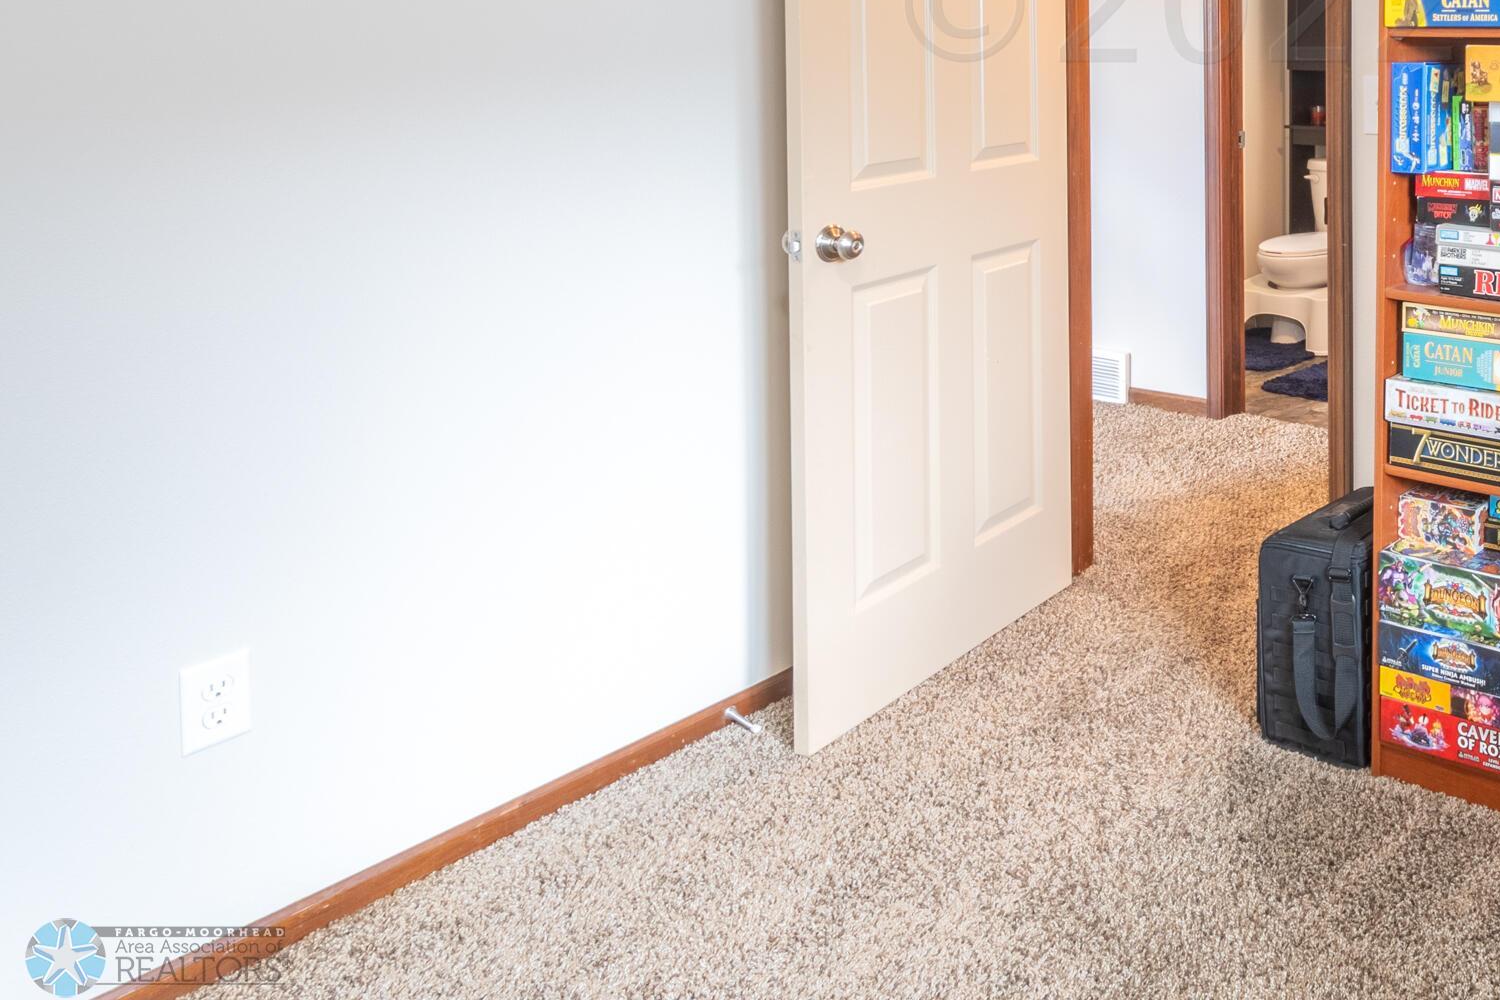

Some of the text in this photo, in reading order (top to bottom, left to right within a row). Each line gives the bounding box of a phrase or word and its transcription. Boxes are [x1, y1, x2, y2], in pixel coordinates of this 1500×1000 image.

[1432, 13, 1461, 22] SETTLERS
[1470, 13, 1498, 22] AMERICA
[1422, 175, 1489, 191] MUNCHKIN MARVEL
[1440, 315, 1496, 333] MUNCHKIN
[1424, 341, 1473, 364] CATAN
[1434, 365, 1463, 377] JUNIOR
[1395, 388, 1448, 414] TICKET
[1452, 402, 1465, 414] TO
[1412, 428, 1432, 463] 7
[1431, 588, 1479, 614] DUNGEON
[1422, 664, 1439, 673] SUPER
[1440, 668, 1458, 679] NINJA
[1460, 673, 1486, 687] AMBUSH!
[1457, 735, 1475, 750] OF
